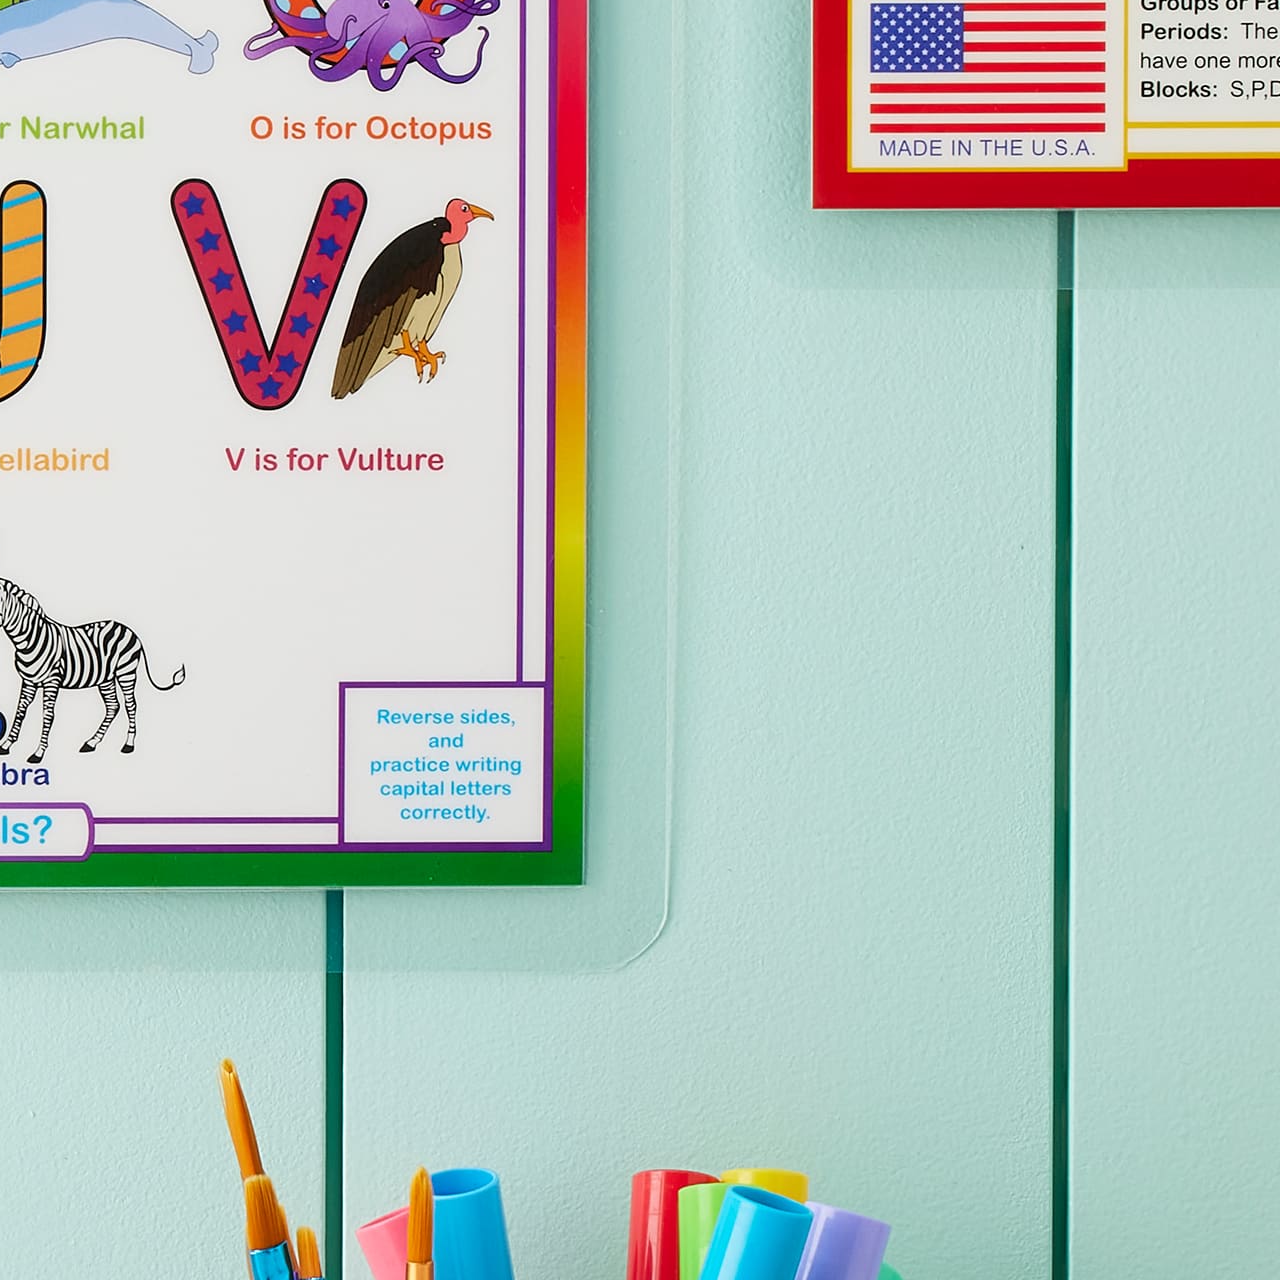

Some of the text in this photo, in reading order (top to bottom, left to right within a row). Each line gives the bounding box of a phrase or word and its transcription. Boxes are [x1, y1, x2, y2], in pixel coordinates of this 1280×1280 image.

[1142, 23, 1278, 39] Periods: The
[1141, 52, 1230, 68] have one
[1141, 81, 1217, 97] Blocks:
[21, 116, 144, 139] Narwhal
[880, 139, 1095, 156] MADE IN THE U.S.A.
[170, 179, 368, 410] V
[378, 709, 515, 726] Reverse sides,
[429, 733, 464, 748] and
[371, 757, 521, 775] practice writing
[380, 781, 511, 799] capital letters
[400, 804, 490, 823] correctly.
